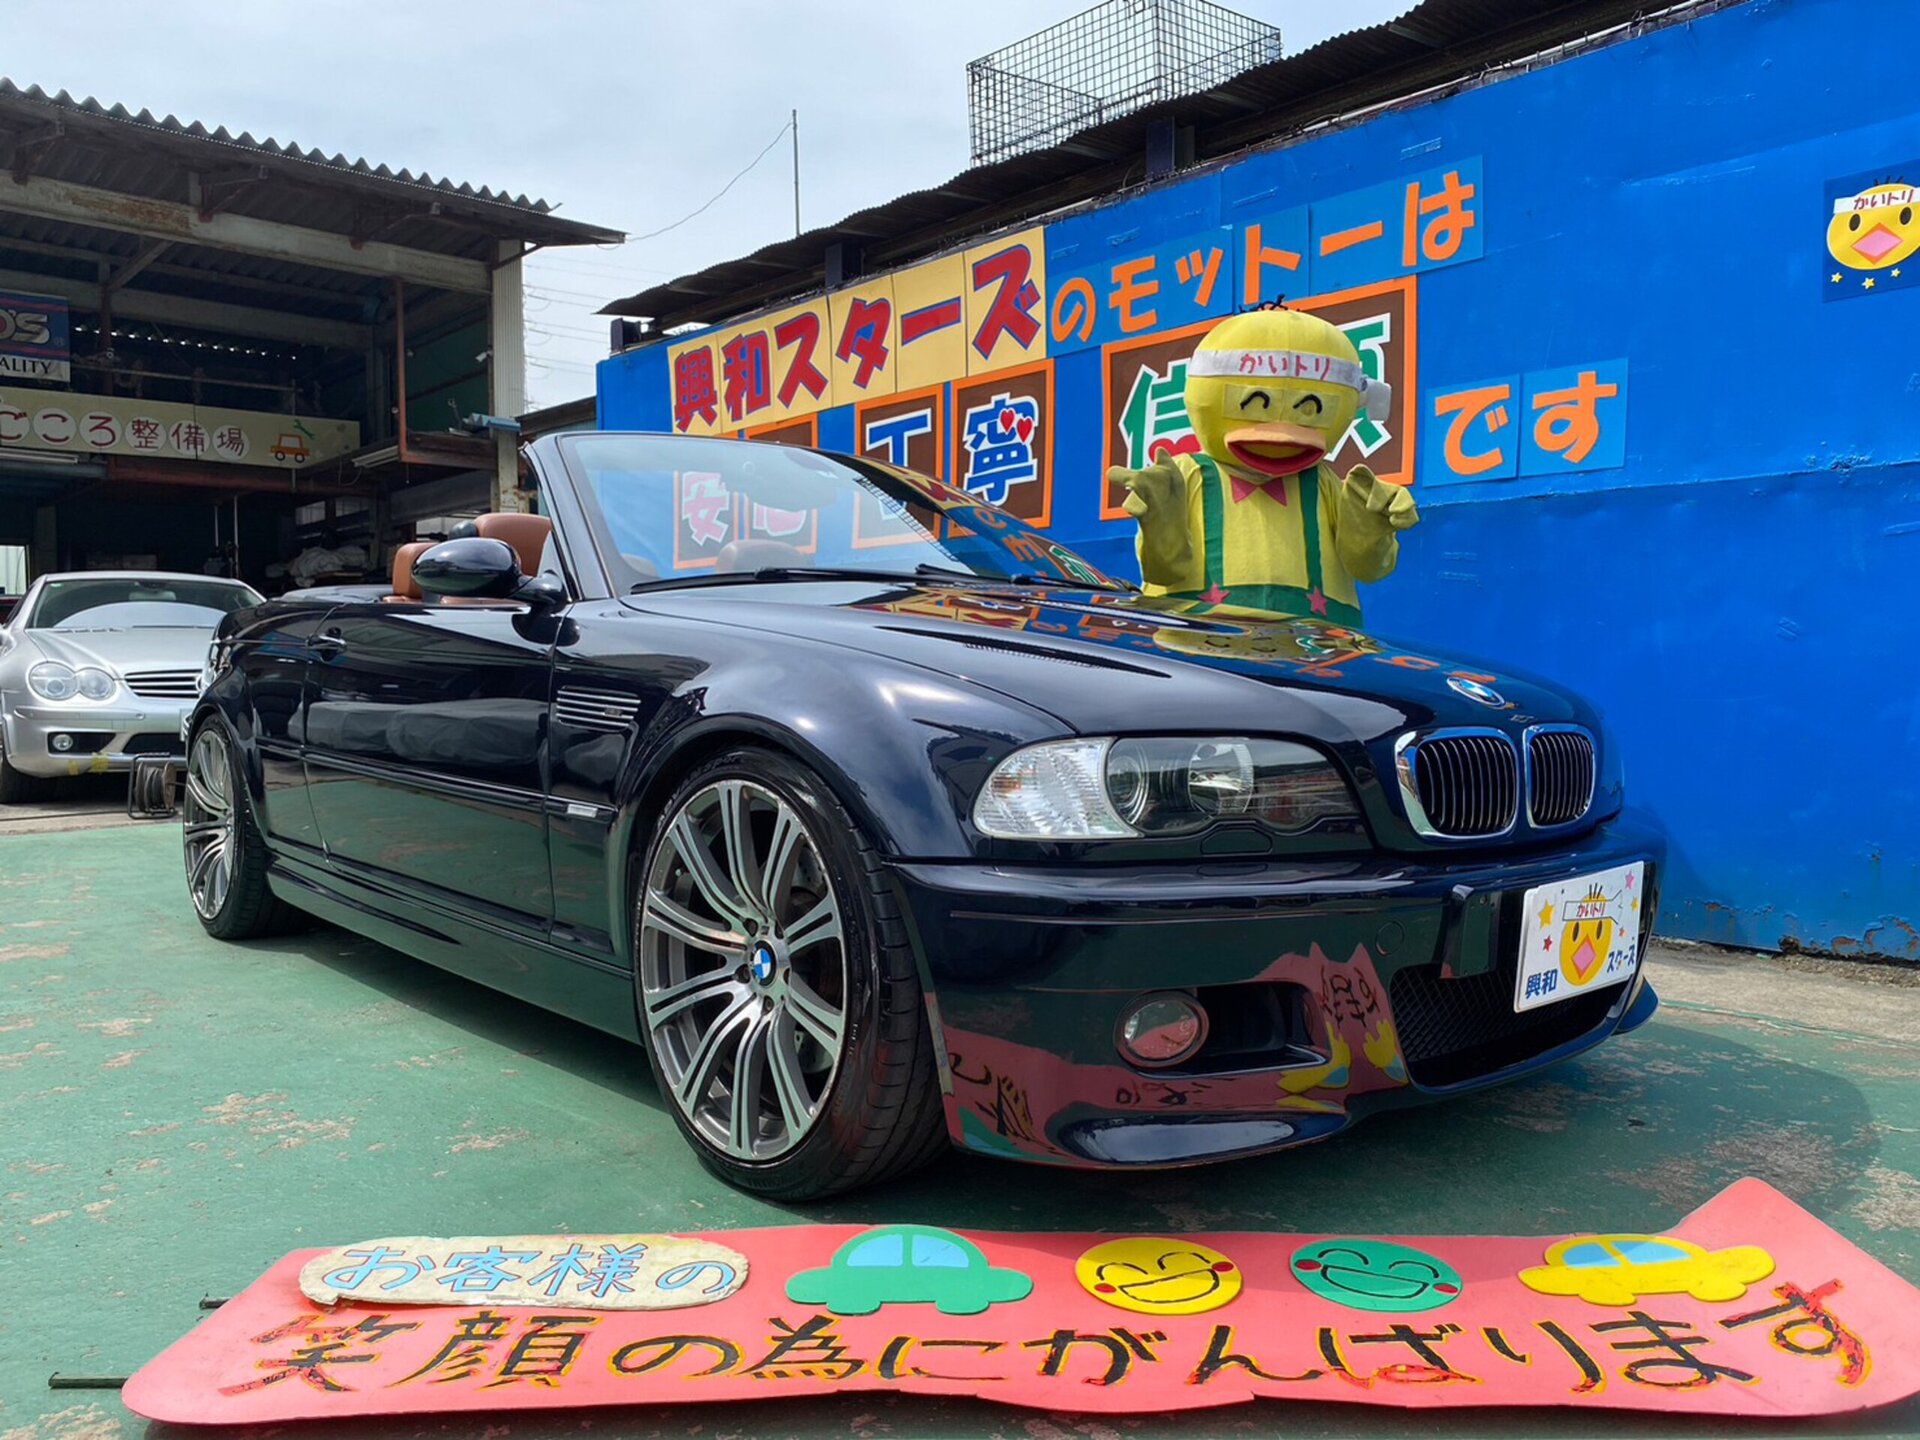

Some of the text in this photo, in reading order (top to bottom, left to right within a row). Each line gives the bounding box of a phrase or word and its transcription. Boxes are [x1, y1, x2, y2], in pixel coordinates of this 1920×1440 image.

[1853, 188, 1915, 211] かいトリ
[1051, 169, 1475, 343] のモットーは
[673, 243, 1042, 432] 興和スターズ
[1238, 352, 1331, 380] かいトリ
[1434, 371, 1617, 475] です
[1576, 903, 1606, 918] かいトリ
[1525, 968, 1558, 999] 興和
[322, 1243, 739, 1298] お客様の
[217, 1278, 1873, 1396] 笑顔の為にがんばります
